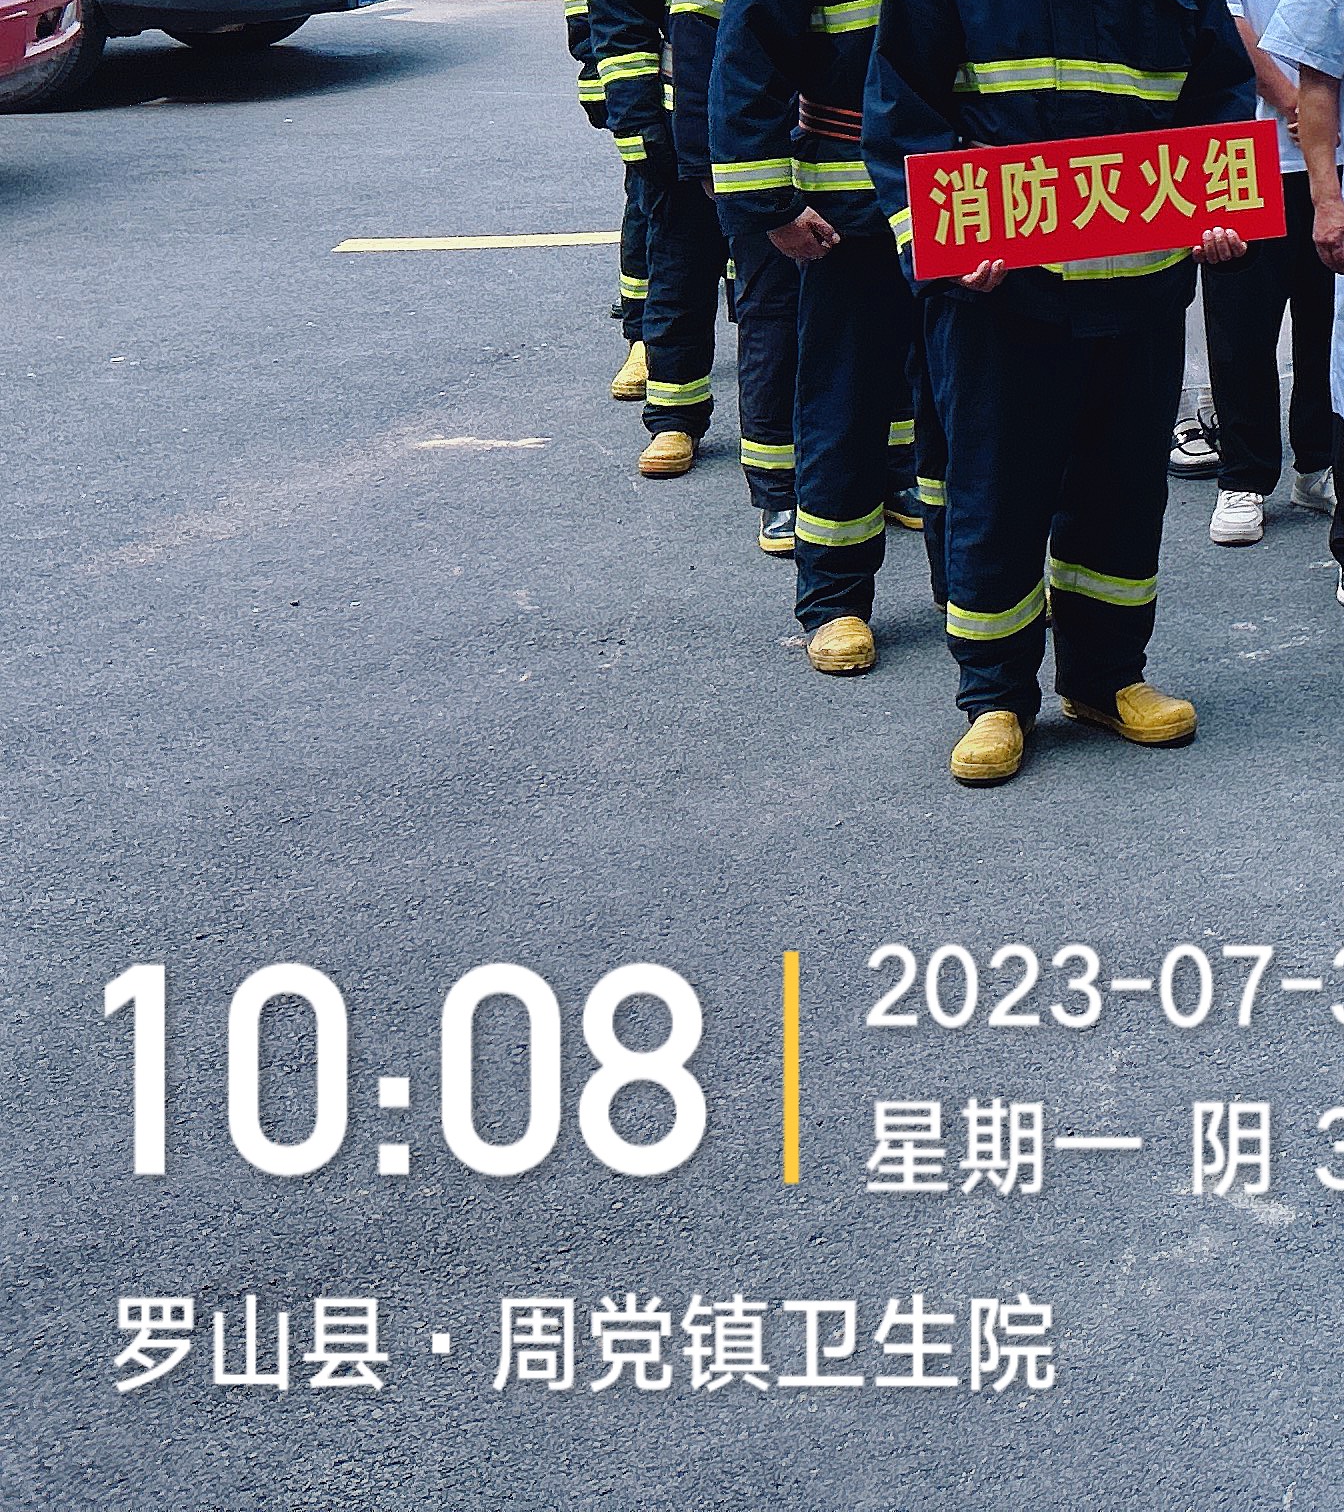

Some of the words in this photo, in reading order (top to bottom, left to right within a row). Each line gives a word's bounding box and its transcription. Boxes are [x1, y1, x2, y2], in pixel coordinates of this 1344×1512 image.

[929, 137, 1265, 246] 消防灭火组
